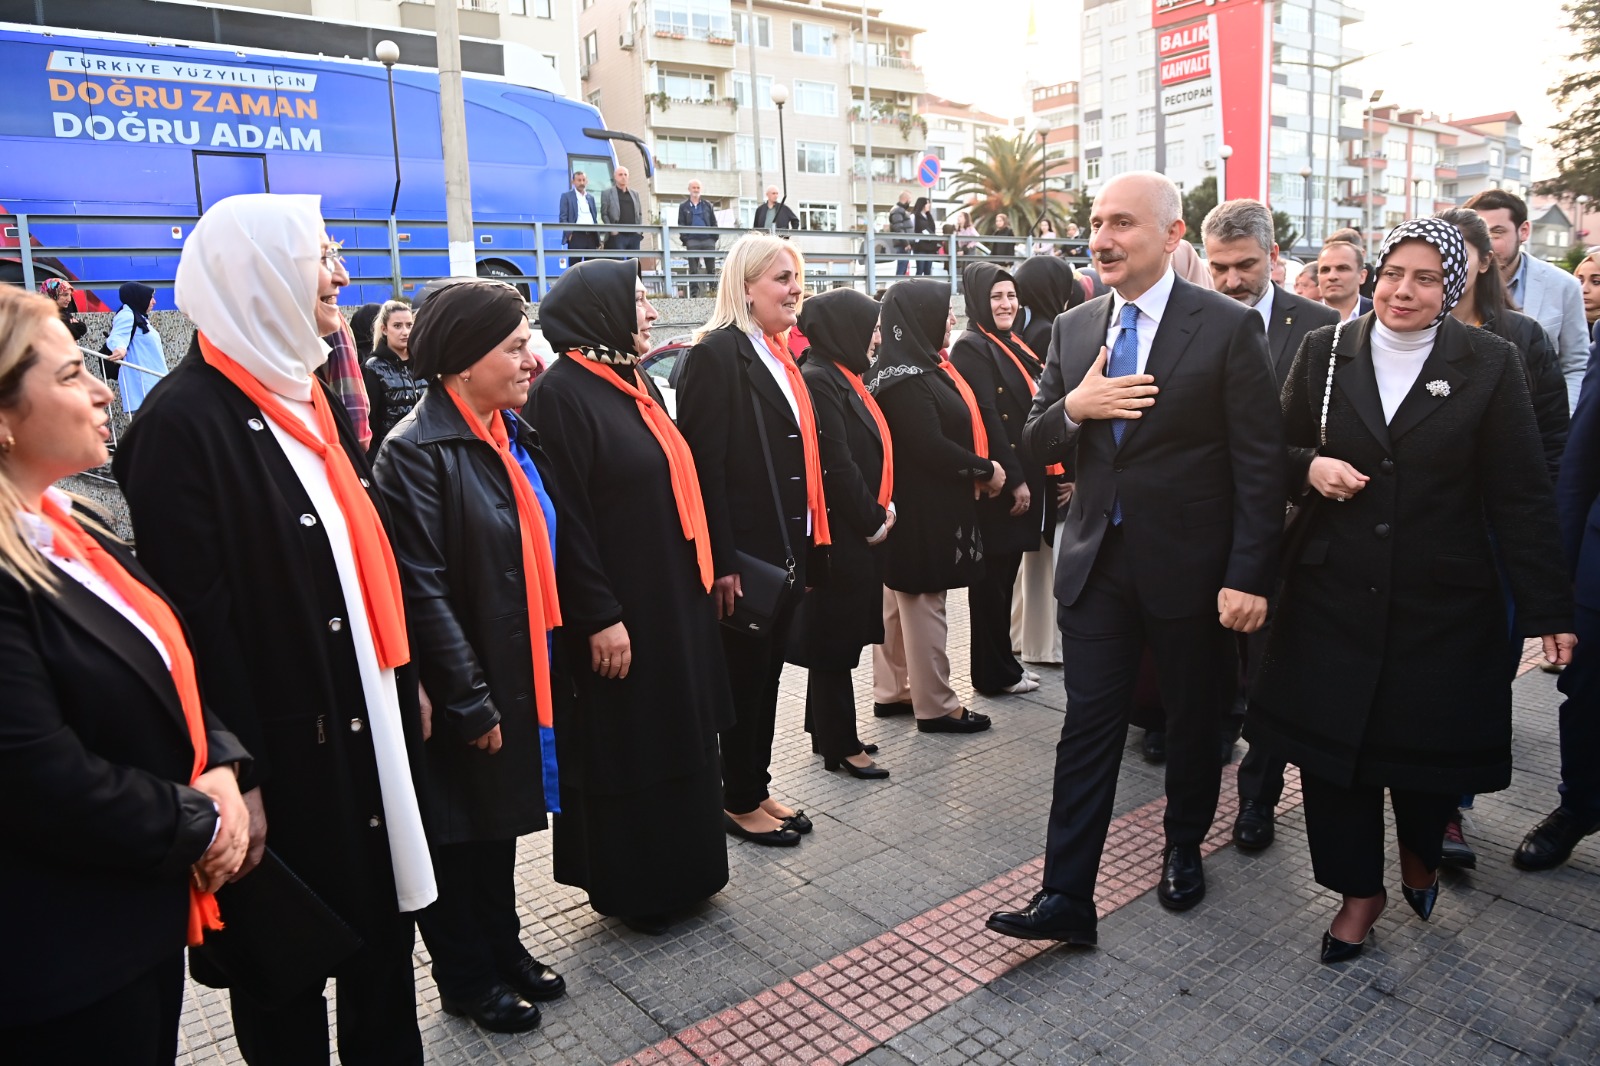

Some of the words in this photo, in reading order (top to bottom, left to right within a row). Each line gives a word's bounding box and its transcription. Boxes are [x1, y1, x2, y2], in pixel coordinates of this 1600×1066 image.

[1160, 25, 1210, 52] BALIK
[64, 56, 160, 75] TÜRKİYE
[173, 66, 255, 83] YÜZYILI
[267, 74, 306, 87] İÇİN
[49, 78, 183, 110] DOĞRU
[191, 89, 318, 120] ZAMAN
[1165, 86, 1212, 106] РЕСТОРАН
[53, 110, 200, 145] DOĞRU
[210, 122, 322, 152] ADAM
